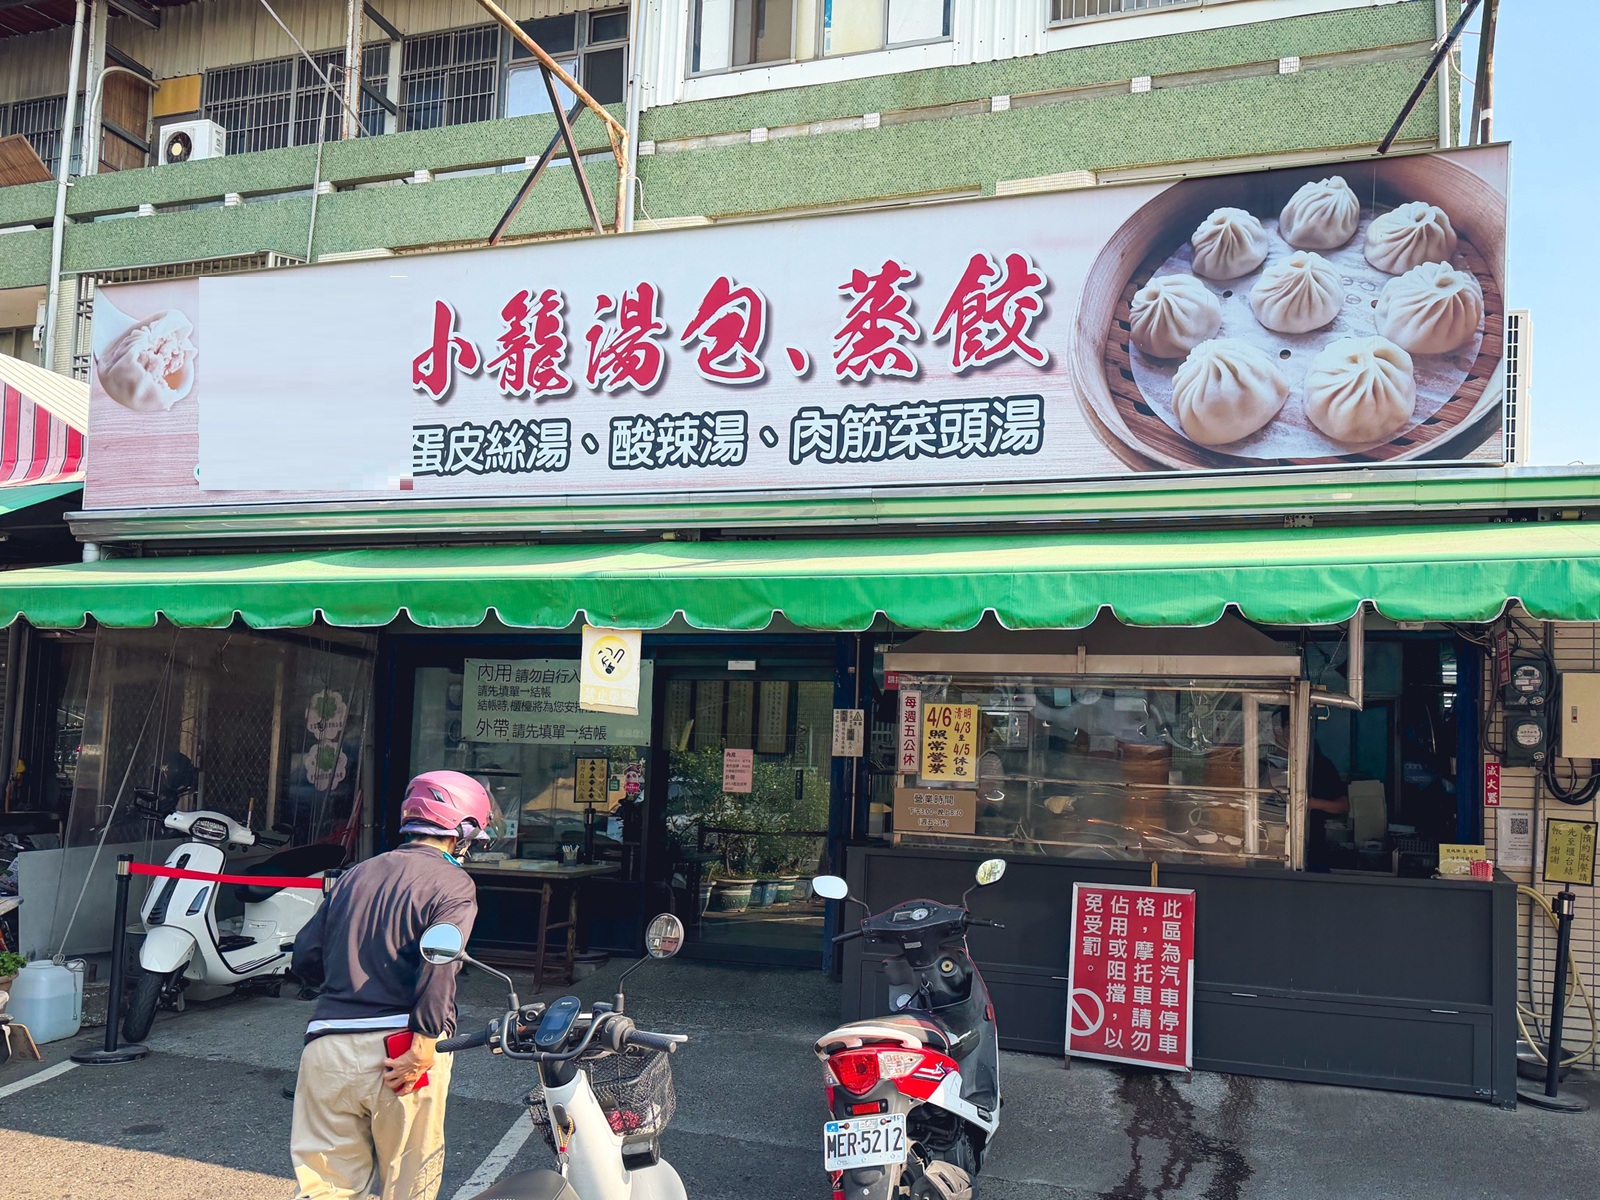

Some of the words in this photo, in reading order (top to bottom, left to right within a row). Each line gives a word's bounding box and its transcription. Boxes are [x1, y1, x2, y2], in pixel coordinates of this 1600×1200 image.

[412, 252, 1046, 397] 小籠湯包、蒸餃
[477, 685, 520, 698] 請先填單
[530, 685, 552, 698] 結帳
[926, 706, 952, 728] 4/6
[954, 707, 972, 720] 清明
[476, 717, 510, 738] 外帶
[512, 723, 566, 740] 請先填單
[578, 725, 607, 741] 結帳
[903, 695, 917, 766] 每週五公休
[954, 721, 971, 734] 4/3
[927, 729, 948, 774] 照常營業
[953, 743, 970, 756] 4/5
[953, 756, 968, 776] 休息
[1486, 765, 1499, 804] 滅火器
[914, 793, 954, 806] 營業時間
[1563, 826, 1578, 876] 先至櫃台結
[1130, 896, 1156, 1053] 格，摩托車請勿
[1158, 898, 1183, 1055] 此區為汽車停車
